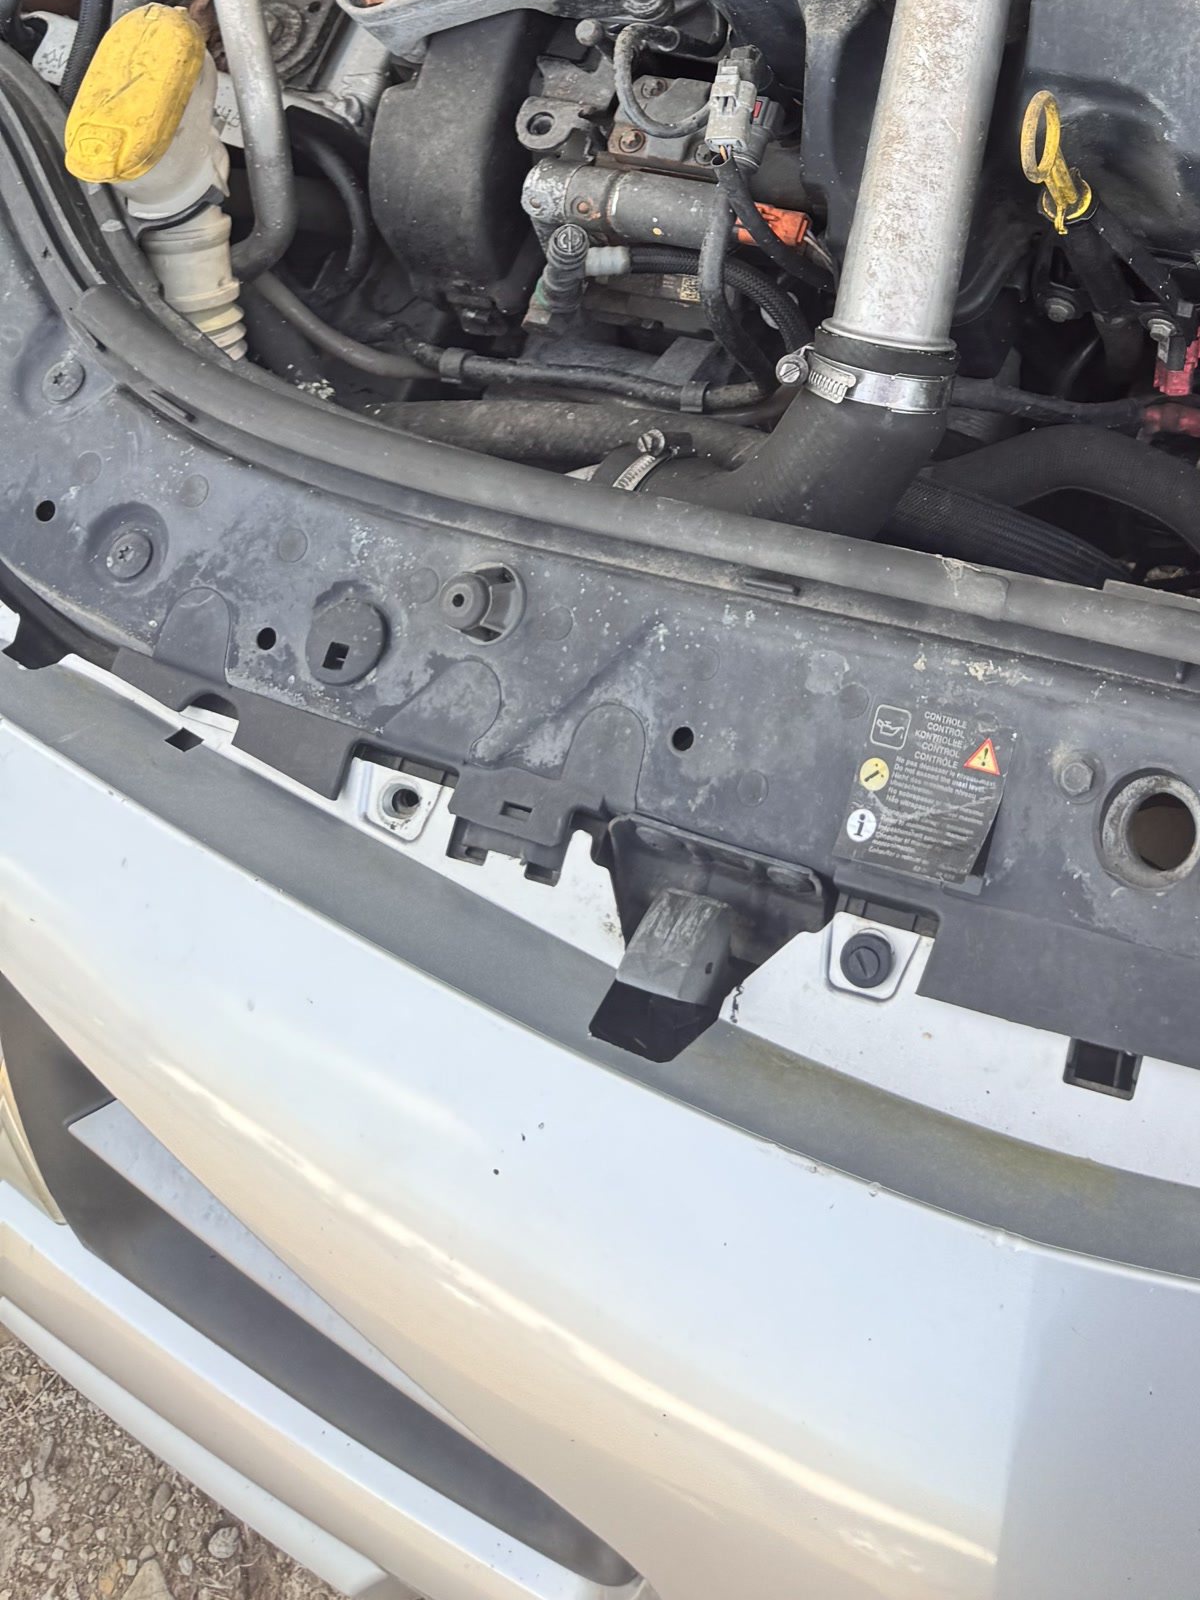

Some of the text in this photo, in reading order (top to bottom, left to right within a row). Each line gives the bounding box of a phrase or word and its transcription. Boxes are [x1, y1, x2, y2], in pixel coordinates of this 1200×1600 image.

[924, 711, 967, 728] CONTROLE
[927, 722, 965, 738] CONTROL
[921, 741, 960, 758] CONTROL
[914, 749, 958, 768] CONTRÔLE
